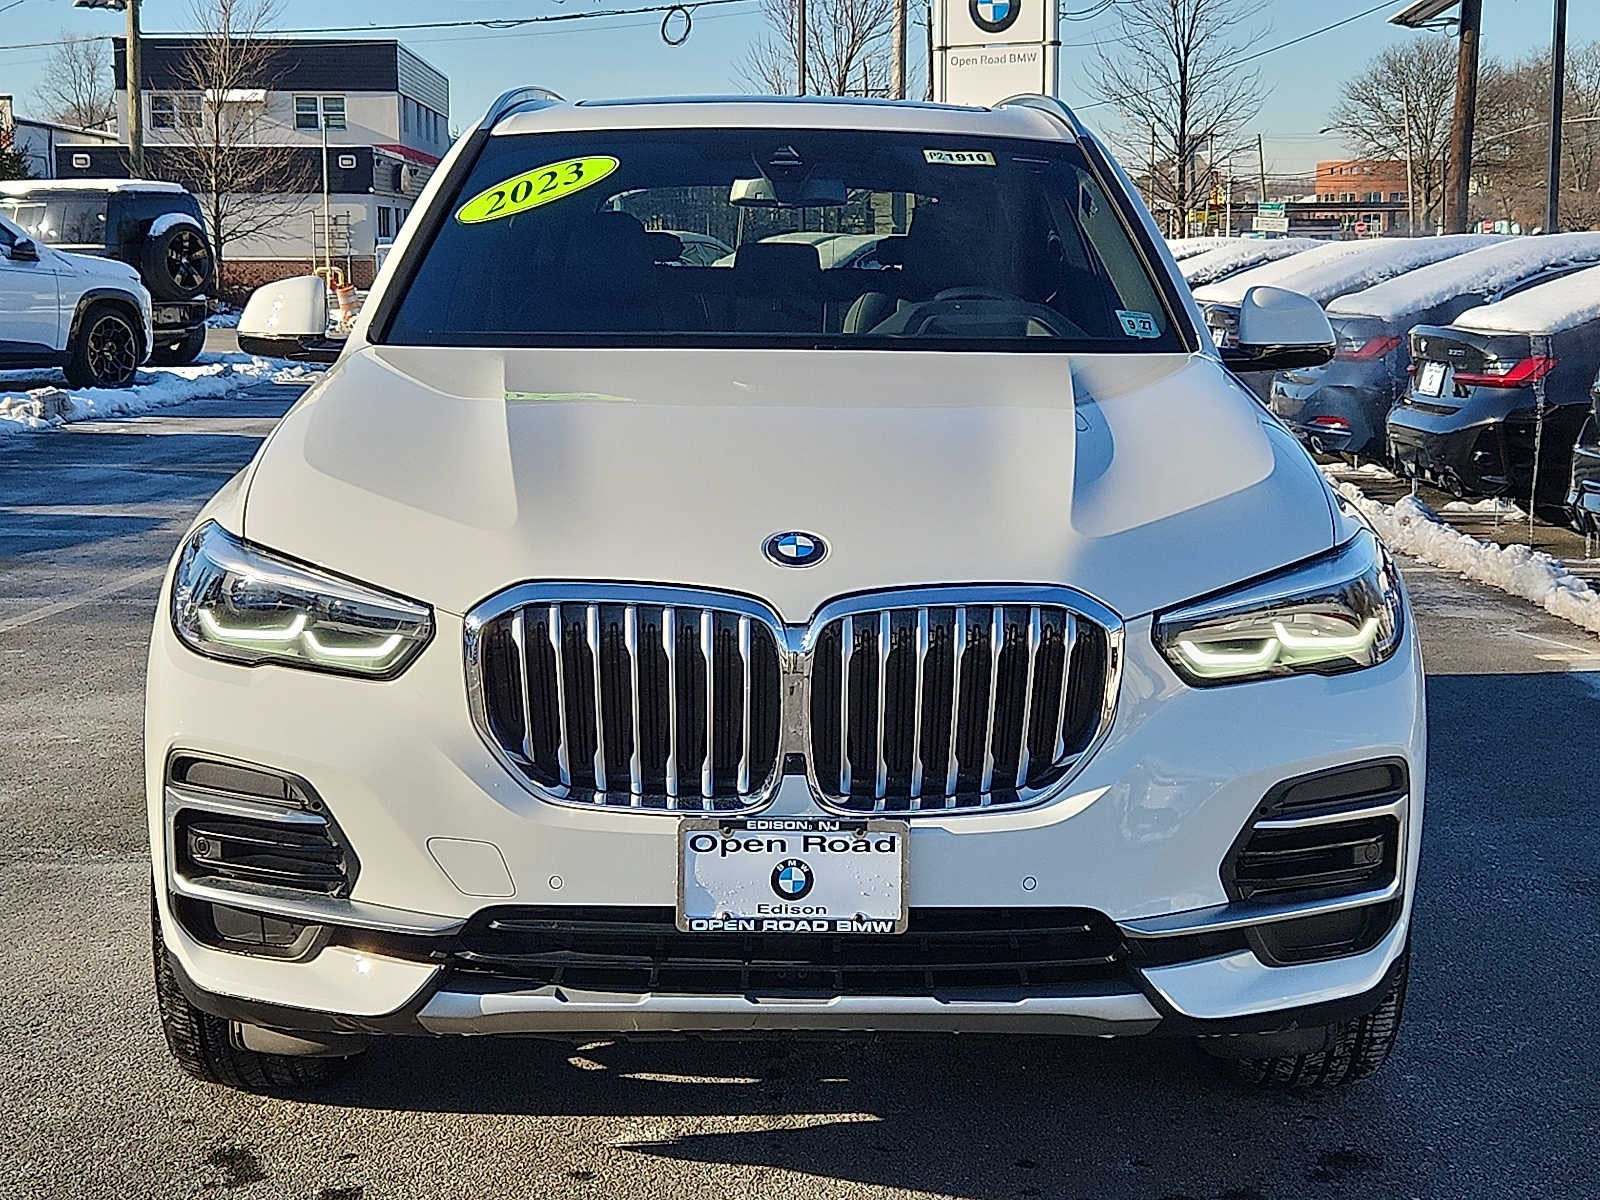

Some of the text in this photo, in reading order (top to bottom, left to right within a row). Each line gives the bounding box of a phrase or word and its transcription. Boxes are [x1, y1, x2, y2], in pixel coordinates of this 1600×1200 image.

[950, 53, 1037, 68] Open Road BMW
[485, 162, 584, 216] 2023
[1127, 319, 1136, 330] 9
[818, 821, 840, 832] NJ
[689, 834, 896, 858] Open Road
[776, 859, 810, 873] BMW
[757, 903, 827, 915] Edison
[691, 919, 894, 933] OPEN ROAD BMW
